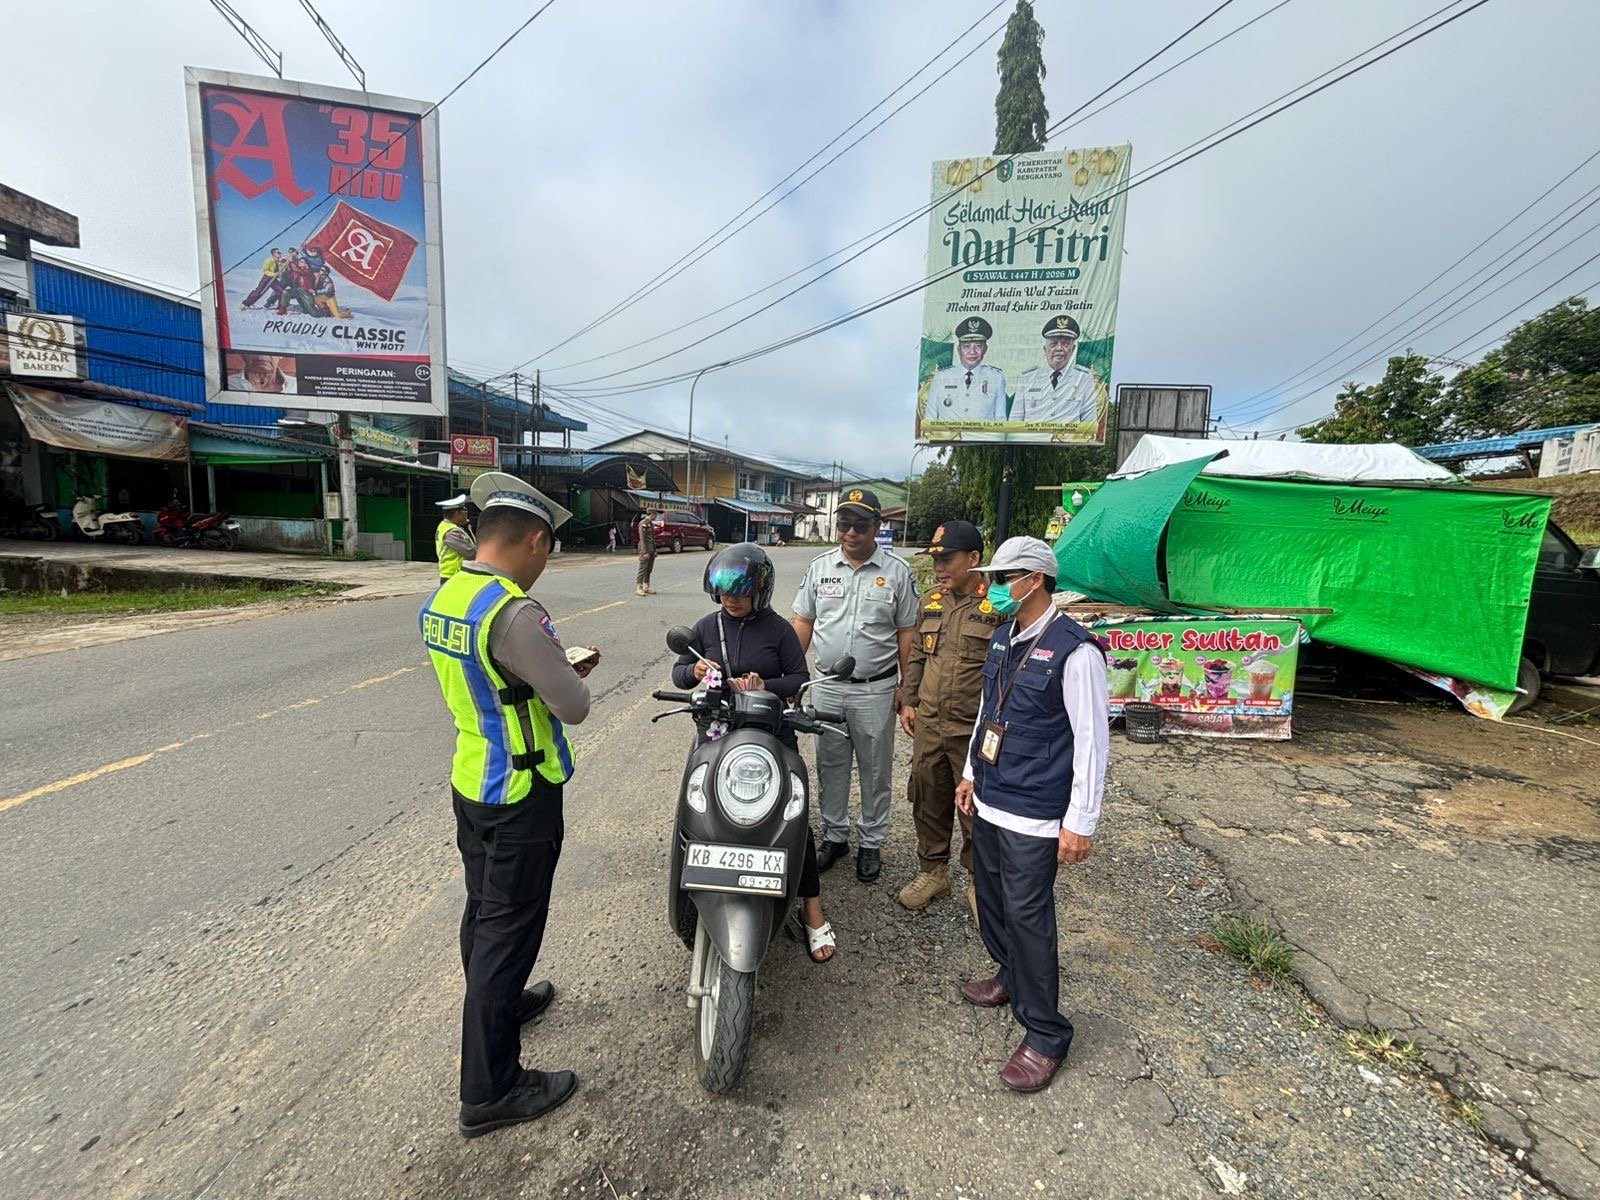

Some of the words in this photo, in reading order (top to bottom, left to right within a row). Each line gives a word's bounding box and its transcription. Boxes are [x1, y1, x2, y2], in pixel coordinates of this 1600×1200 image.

[328, 107, 409, 171] 35
[1017, 158, 1062, 167] PEMERINTAH
[1017, 165, 1058, 174] KABUPATEN
[328, 165, 403, 202] RIBU
[1016, 172, 1062, 181] BENGKAYANG
[943, 198, 1013, 226] Selamat
[1012, 195, 1056, 224] Hari
[1058, 192, 1112, 225] Raya
[942, 226, 1016, 267] Idul
[1027, 224, 1110, 265] Fitri
[972, 271, 1008, 281] SYAWAL
[1010, 270, 1029, 280] 1447
[1031, 270, 1038, 279] H
[1045, 269, 1065, 279] 2026
[1067, 268, 1077, 277] M
[960, 286, 992, 299] Minal
[993, 286, 1023, 298] Aidin
[1023, 285, 1046, 297] Wal
[1046, 284, 1079, 297] Faizin
[946, 303, 981, 313] Mohon
[982, 301, 1010, 313] Maaf
[1011, 300, 1039, 312] Lahir
[1040, 300, 1063, 311] Dan
[1064, 299, 1094, 311] Batin
[263, 319, 328, 338] PROUDLY
[331, 325, 406, 343] CLASSIC
[356, 341, 379, 350] WHY
[380, 342, 405, 351] NOT?
[16, 350, 70, 363] KAISAR
[23, 362, 64, 372] BAKERY
[335, 366, 396, 378] PERINGATAN:
[968, 613, 983, 622] POL
[984, 615, 996, 624] PP
[423, 613, 471, 656] POLISI
[1107, 629, 1174, 651] Teler
[1182, 627, 1281, 652] Sultan
[692, 848, 711, 865] KB
[719, 851, 755, 868] 4296
[763, 854, 783, 872] KX
